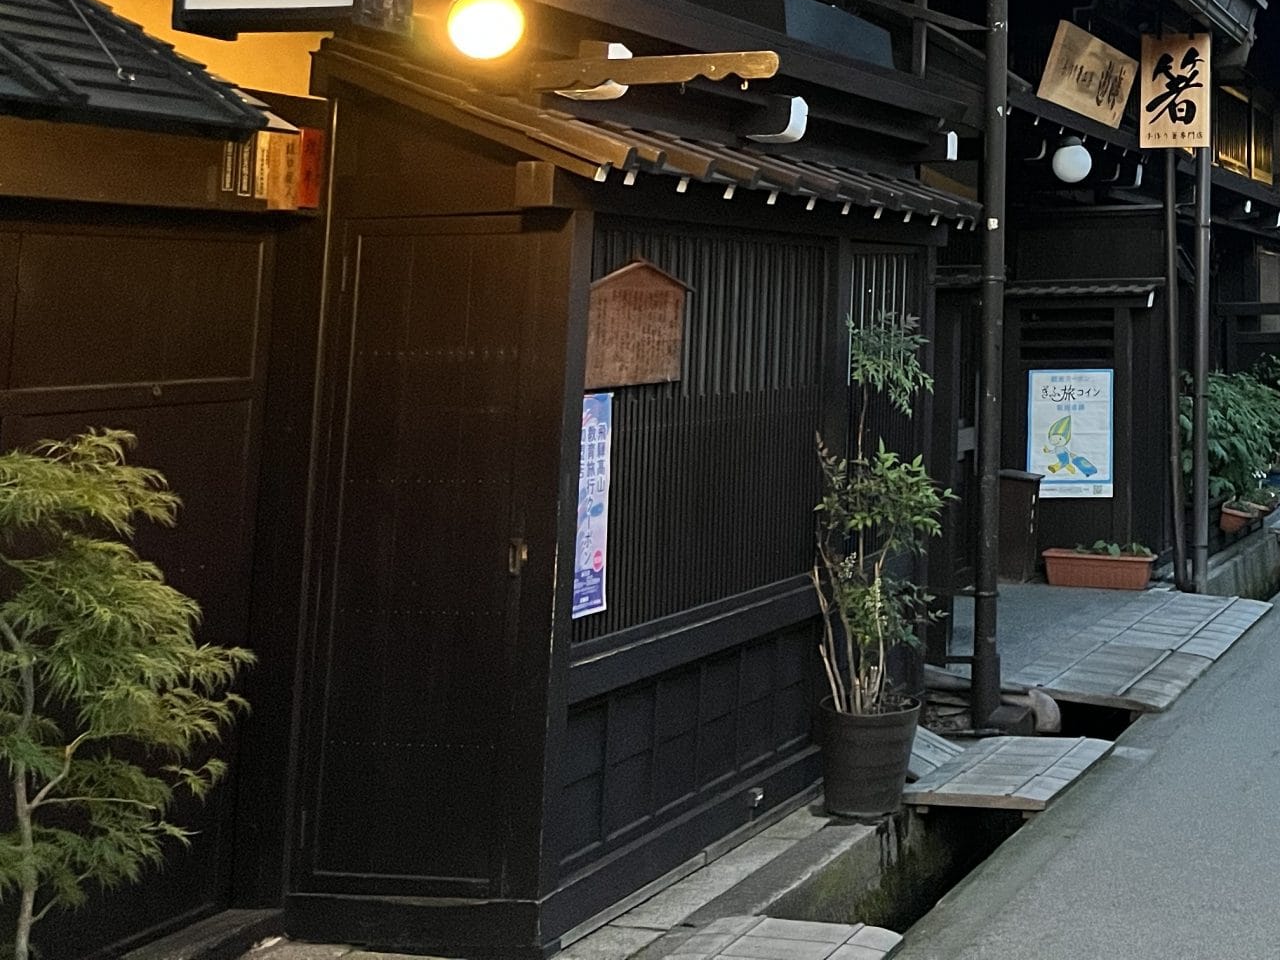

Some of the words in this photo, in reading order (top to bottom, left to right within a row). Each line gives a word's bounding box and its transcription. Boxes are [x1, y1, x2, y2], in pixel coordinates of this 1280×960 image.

[1145, 46, 1205, 125] 箸
[1041, 385, 1100, 402] ぎふ旅コイン
